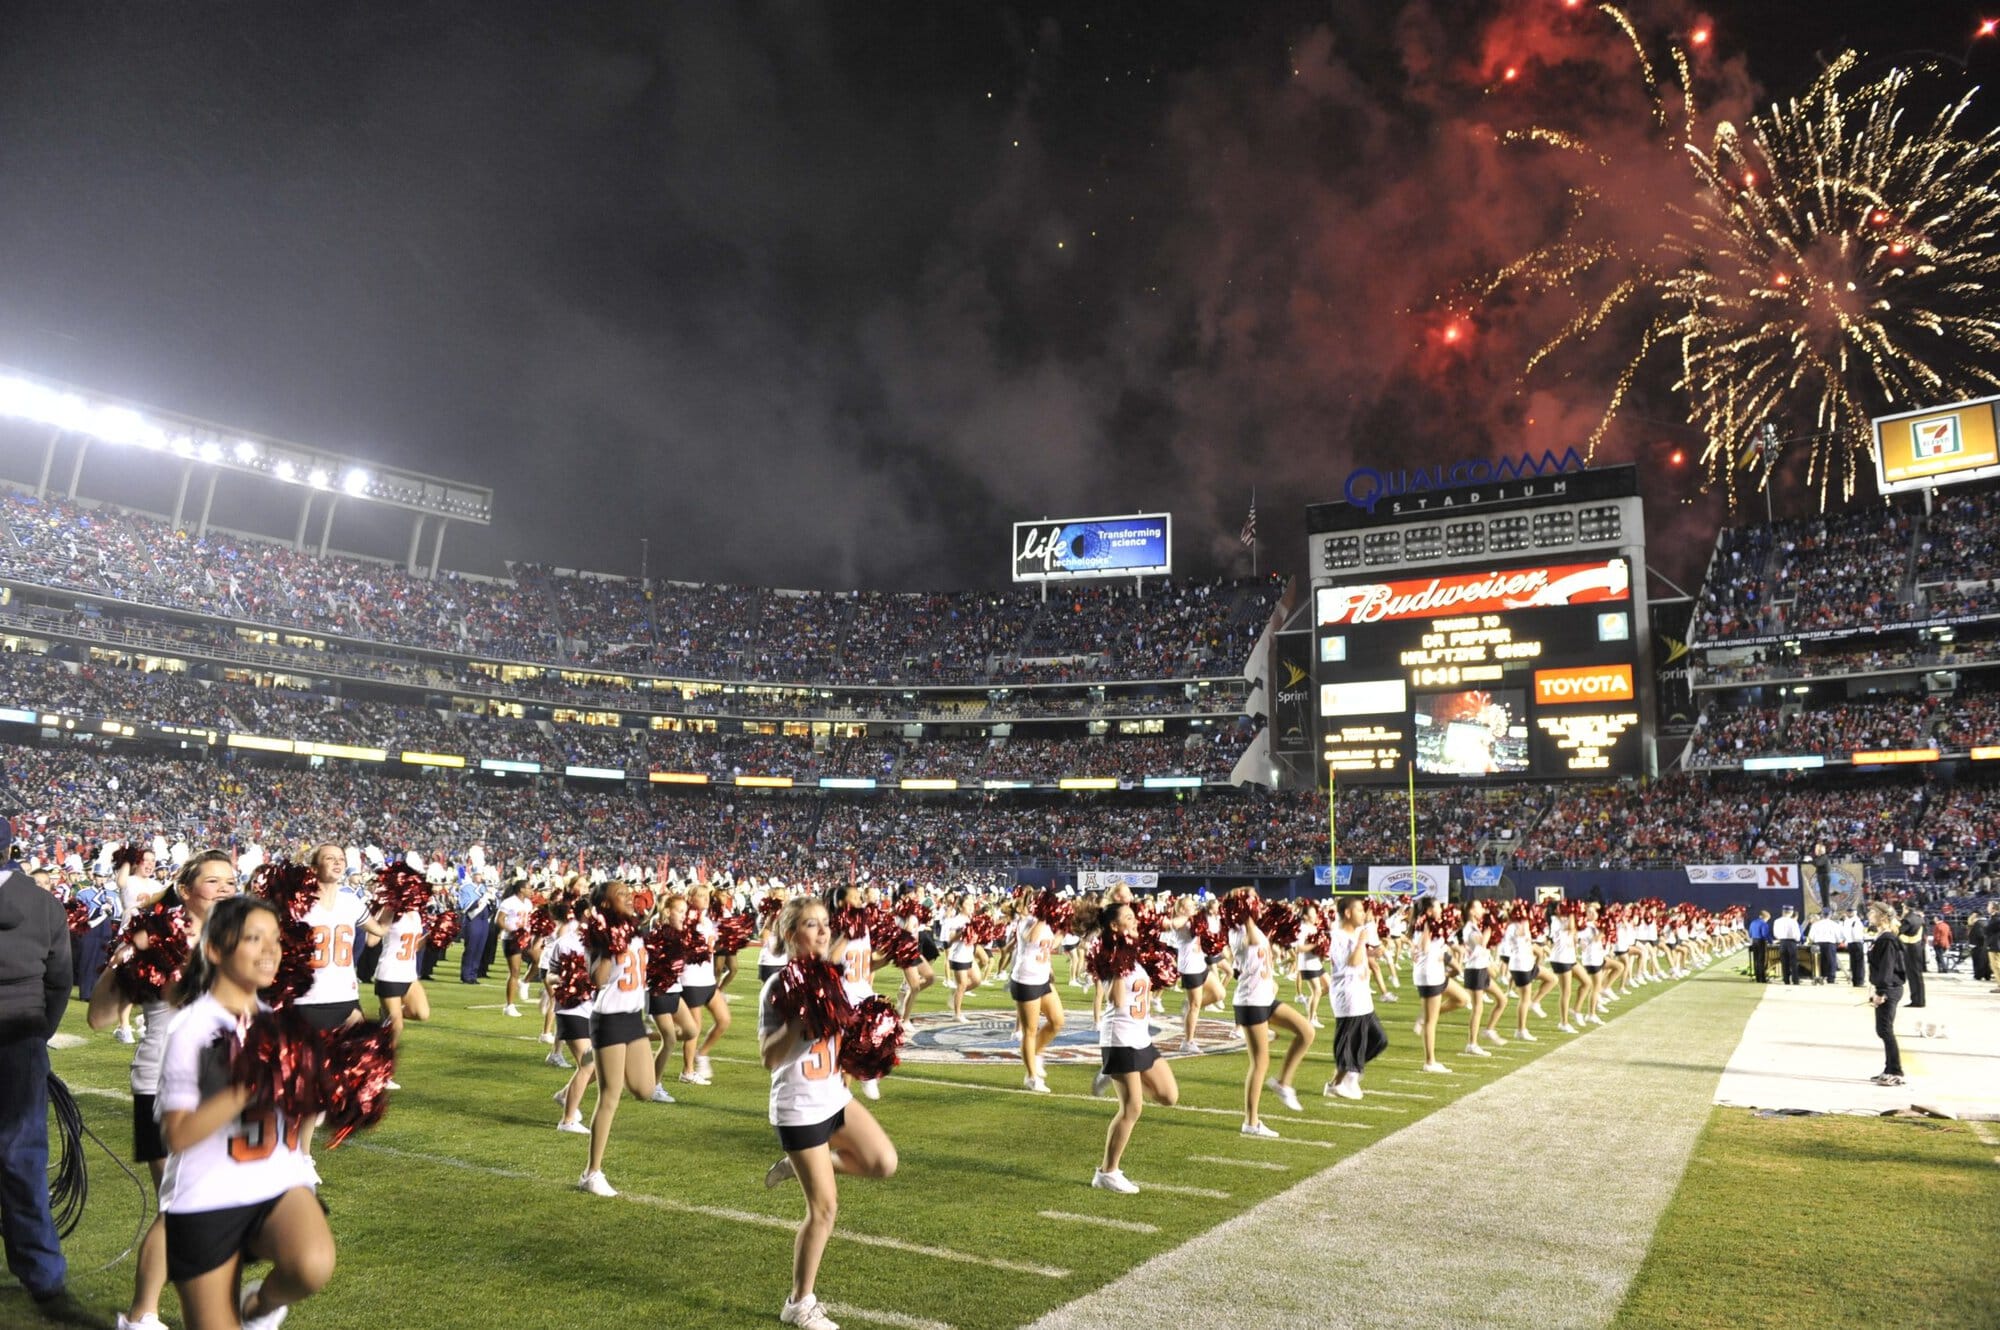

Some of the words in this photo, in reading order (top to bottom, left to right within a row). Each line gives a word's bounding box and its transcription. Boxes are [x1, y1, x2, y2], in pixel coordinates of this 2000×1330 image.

[1344, 447, 1585, 514] QUALCOMM
[1393, 481, 1567, 513] STADIUM
[1098, 528, 1162, 540] Transforming
[1111, 538, 1147, 548] science
[1018, 527, 1067, 571] life
[1349, 569, 1549, 624] Budweiser
[1421, 633, 1446, 649] DR
[1449, 628, 1512, 647] PEPPER
[1727, 639, 1755, 647] CONDUCT
[1494, 641, 1541, 659] SHOW
[1656, 666, 1690, 681] Sprin
[1539, 675, 1629, 697] TOYOTA
[1277, 689, 1309, 704] Sprint
[1085, 873, 1099, 889] A
[1766, 867, 1790, 887] N
[308, 924, 354, 969] 36
